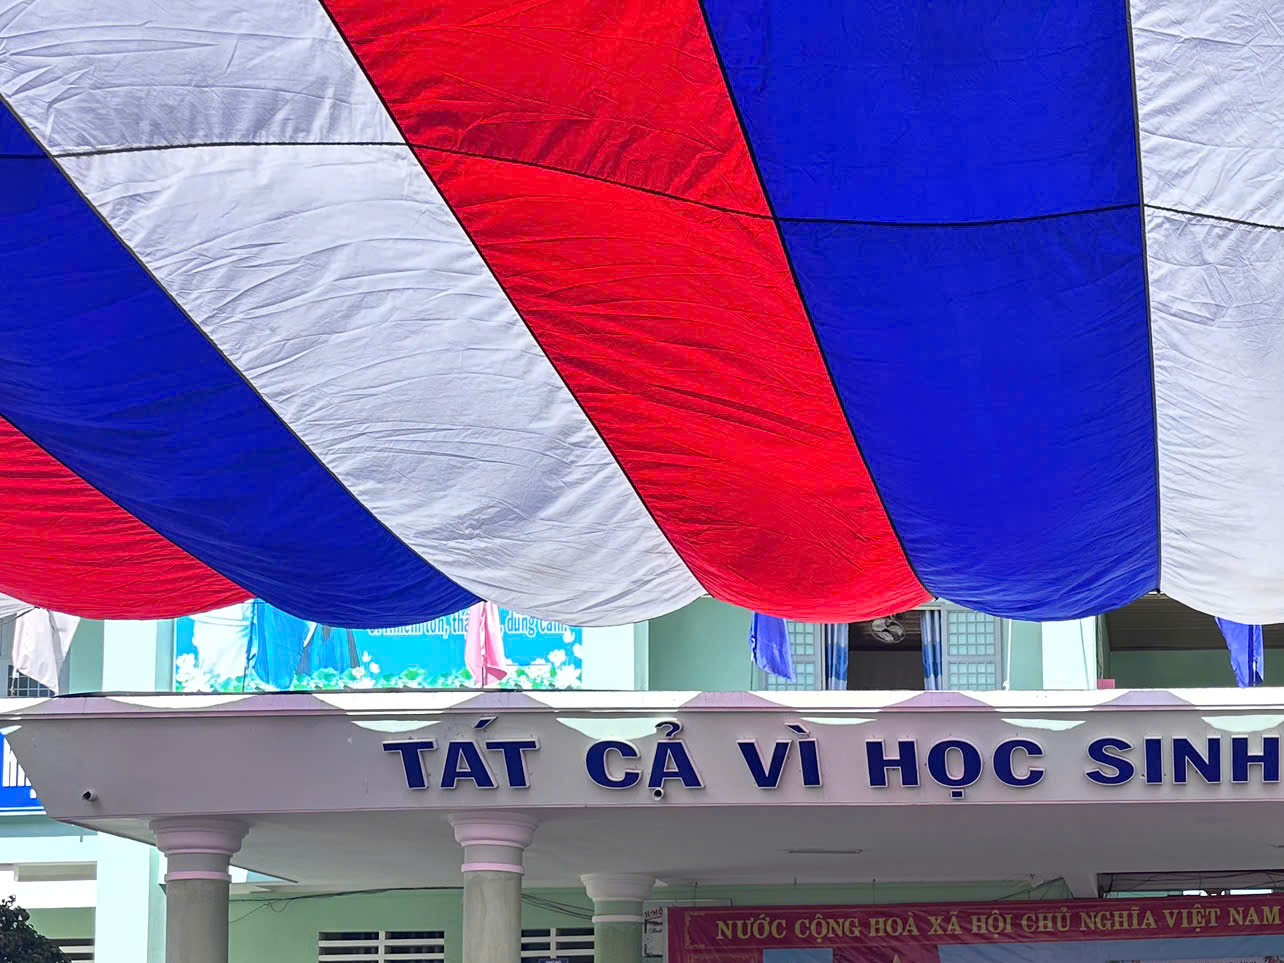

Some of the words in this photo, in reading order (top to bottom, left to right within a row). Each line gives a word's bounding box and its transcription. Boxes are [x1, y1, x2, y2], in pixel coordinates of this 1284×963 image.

[382, 716, 540, 790] TẤT
[584, 720, 704, 789] CẢ
[736, 722, 825, 788] VÌ
[864, 737, 1047, 799] HỌC
[1084, 734, 1282, 785] SINH
[716, 913, 786, 939] NƯỚC
[794, 913, 861, 942] CỘNG
[868, 912, 920, 937] HOÀ
[928, 911, 963, 935] XÃ
[971, 909, 1012, 938] HỘI
[1021, 906, 1071, 932] CHỦ
[1079, 906, 1158, 931] NGHĨA
[1163, 903, 1221, 932] VIỆT
[1227, 905, 1281, 926] NAM
